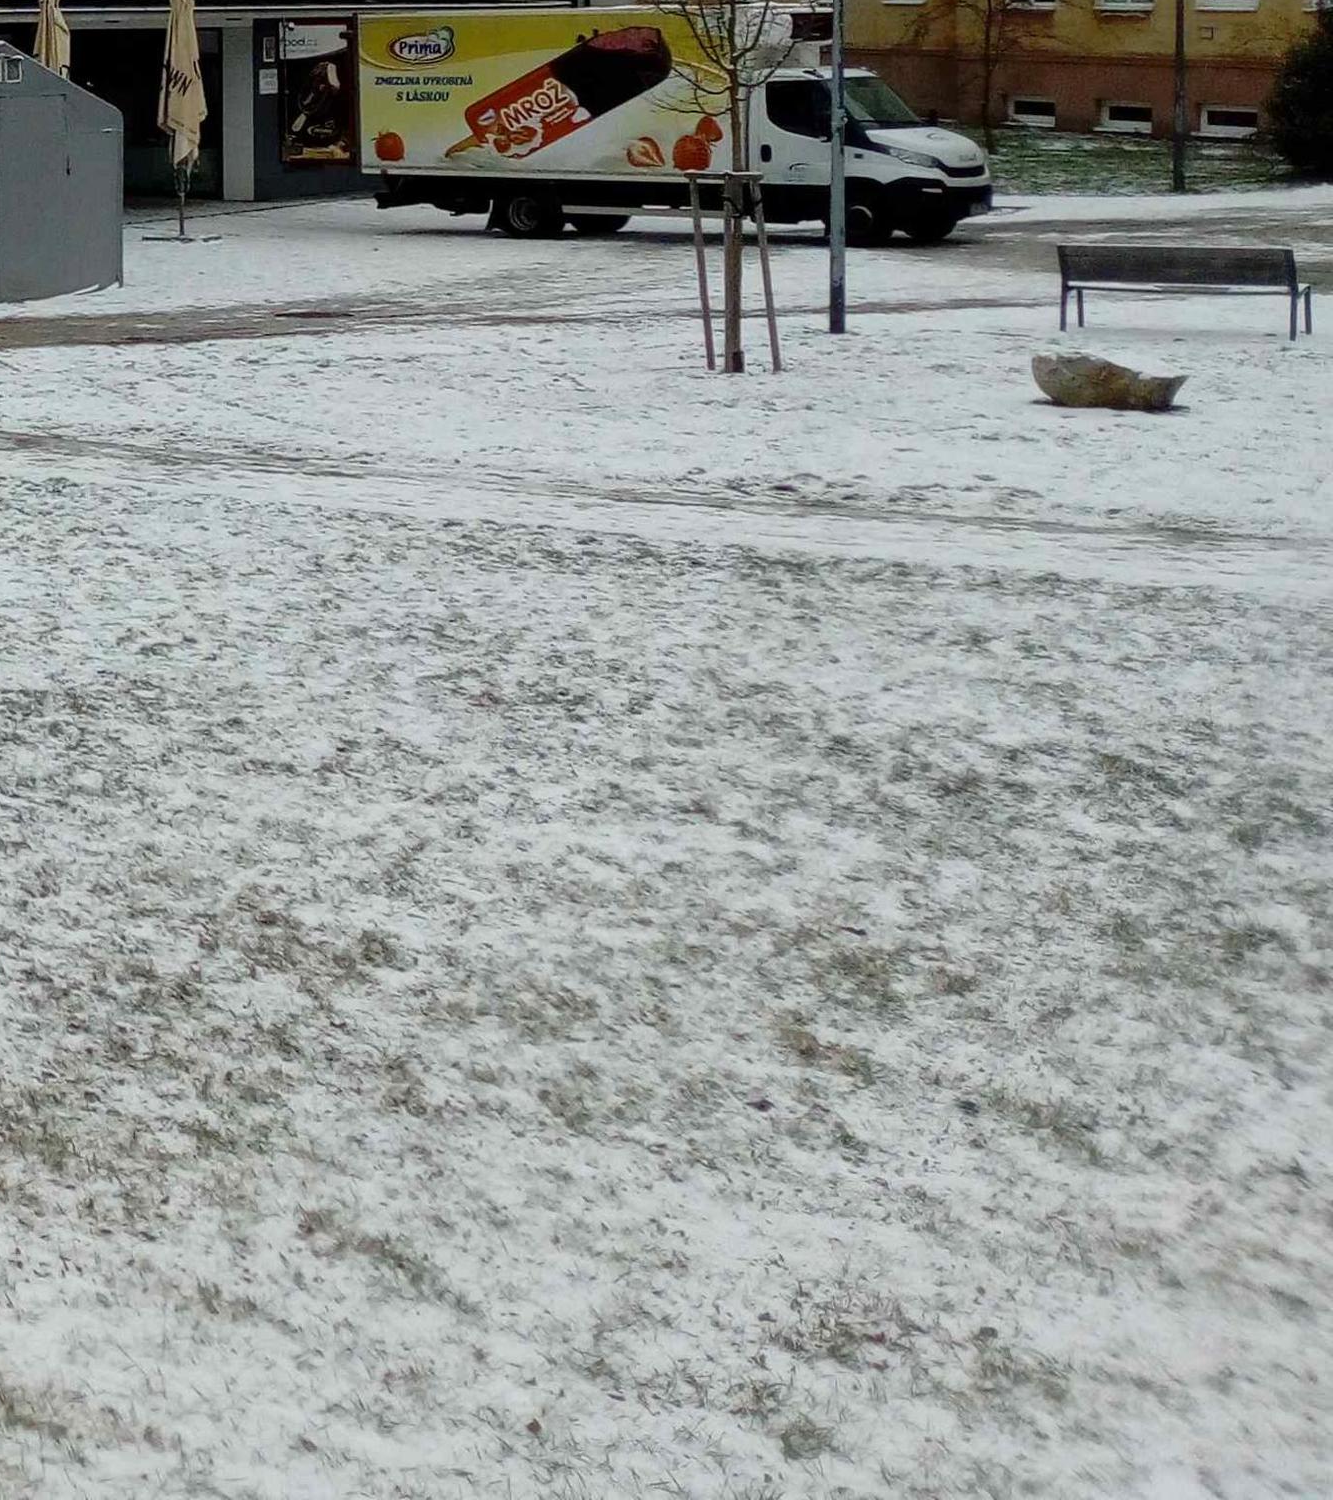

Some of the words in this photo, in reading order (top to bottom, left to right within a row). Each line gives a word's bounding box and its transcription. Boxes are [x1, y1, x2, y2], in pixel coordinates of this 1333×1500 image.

[399, 41, 442, 55] Prima
[396, 91, 404, 102] S
[501, 79, 569, 130] MROŽ
